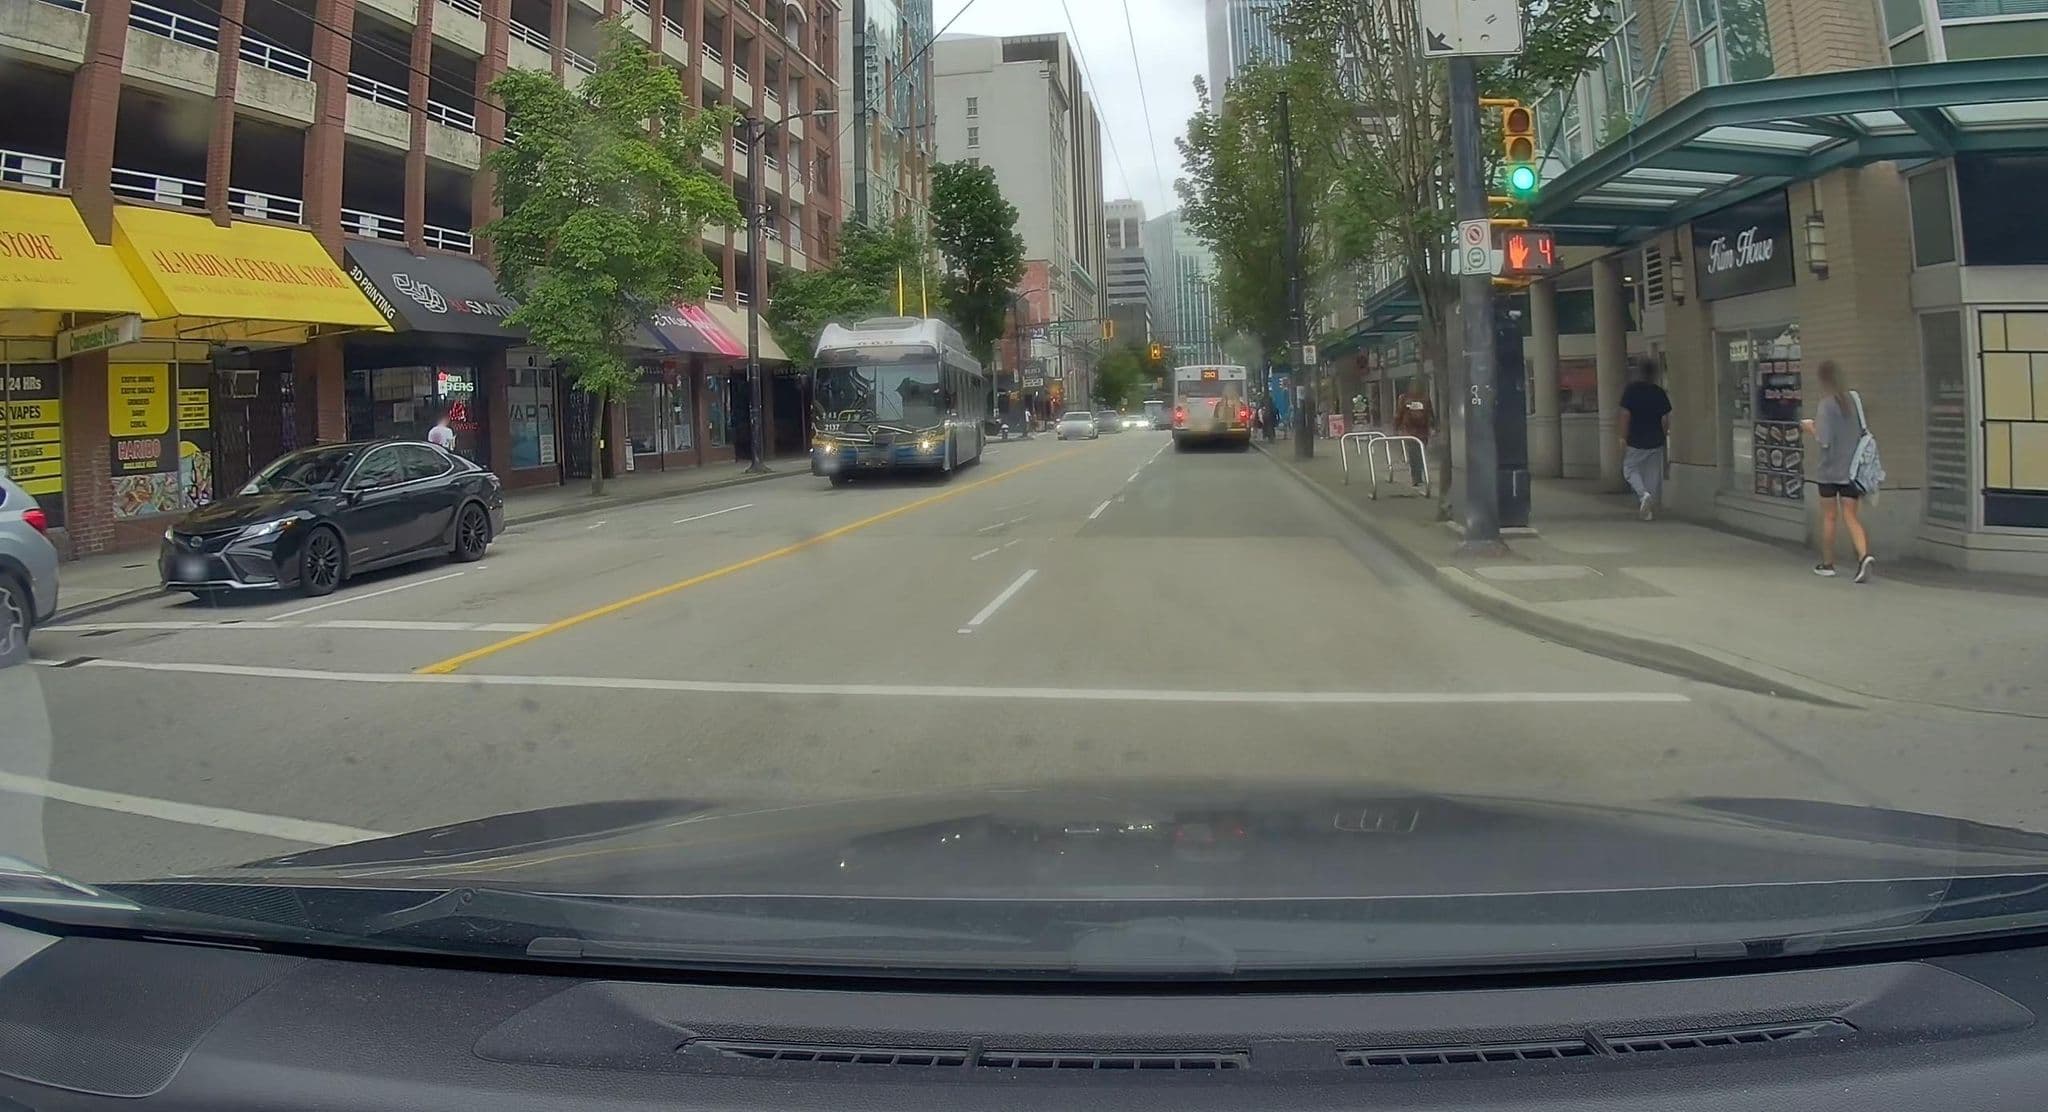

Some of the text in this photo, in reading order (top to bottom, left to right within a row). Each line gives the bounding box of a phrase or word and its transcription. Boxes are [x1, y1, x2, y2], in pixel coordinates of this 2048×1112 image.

[1538, 239, 1551, 265] 4
[235, 257, 308, 286] GENERAL
[298, 264, 350, 289] STORE
[349, 265, 397, 320] 3D PRINTING
[9, 378, 21, 390] 24
[23, 376, 42, 390] HRs
[9, 405, 41, 420] VAPES
[118, 438, 161, 460] HARIBO
